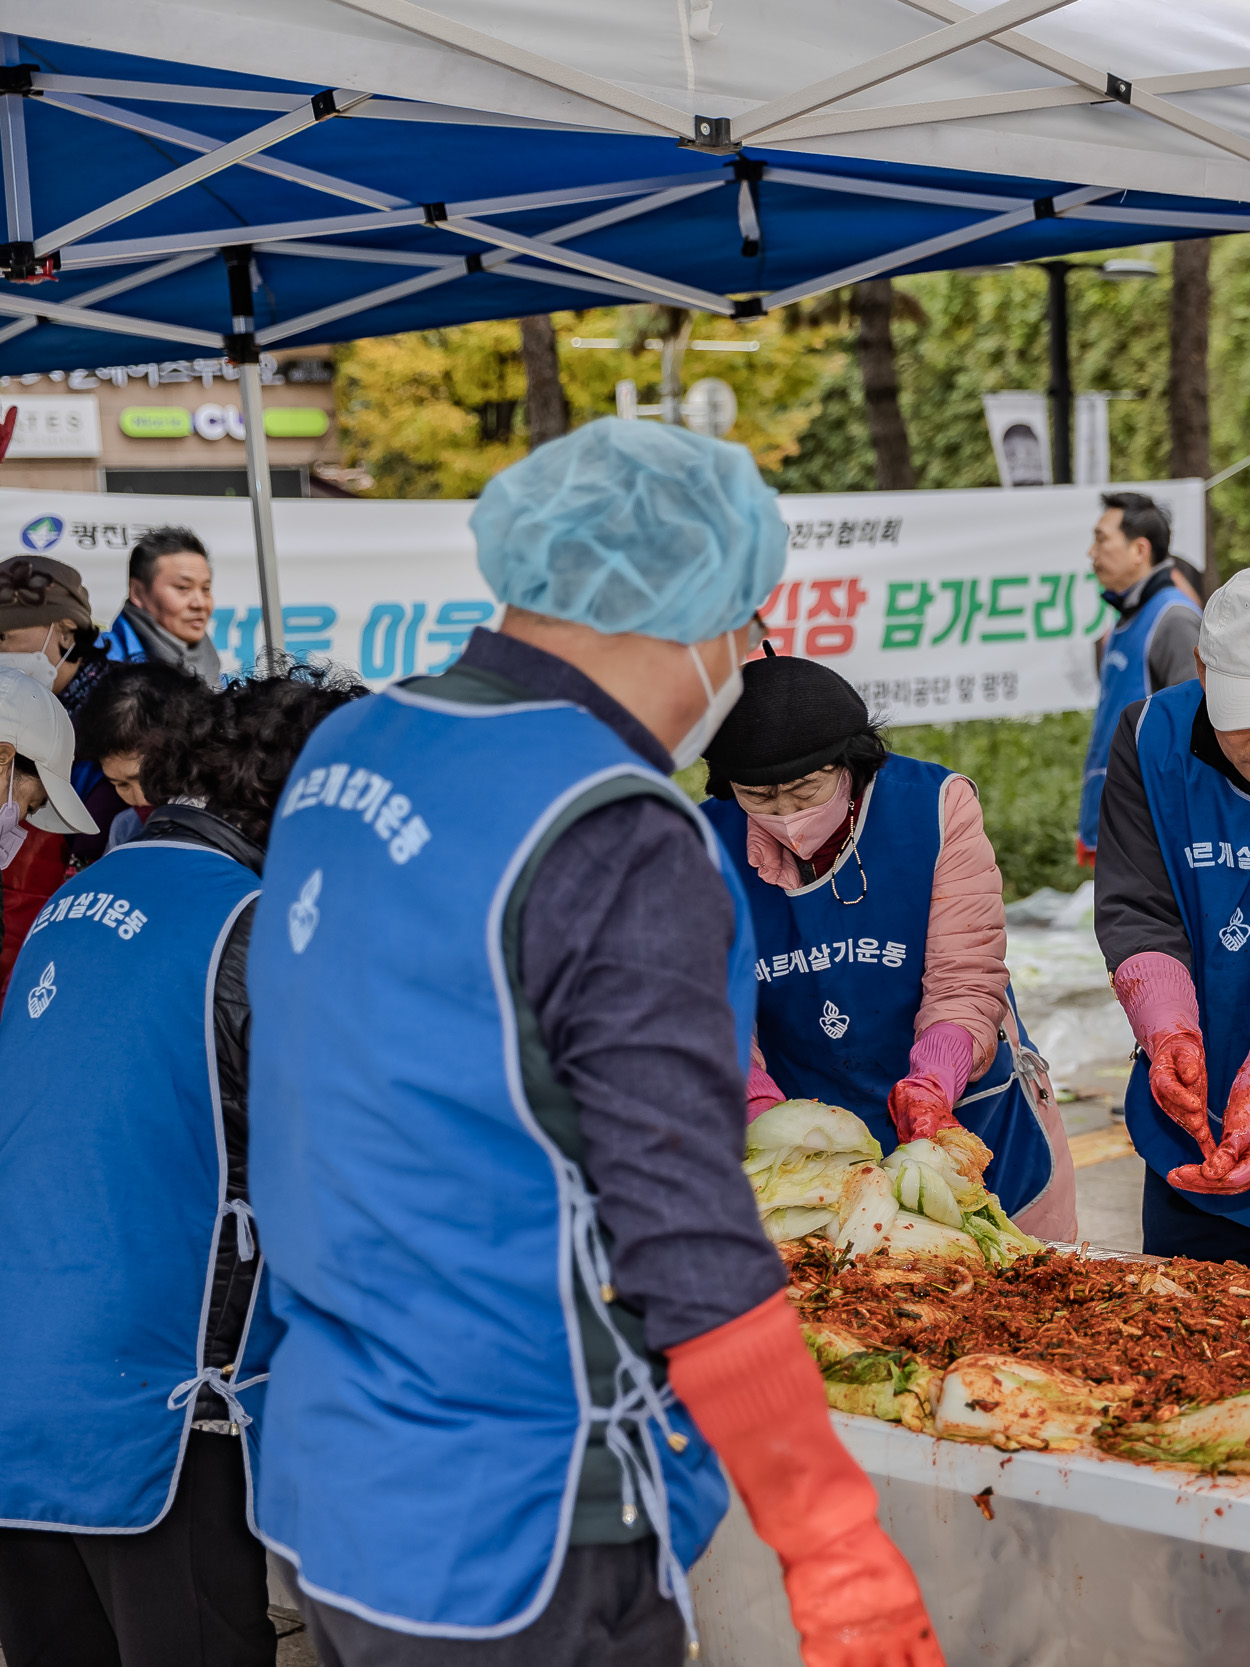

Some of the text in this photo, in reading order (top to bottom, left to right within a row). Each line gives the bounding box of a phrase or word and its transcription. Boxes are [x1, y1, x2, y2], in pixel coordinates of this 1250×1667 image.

[785, 518, 903, 549] 진구협의회
[23, 891, 148, 940] 르게살기운동
[753, 937, 907, 983] 바르게살기운동
